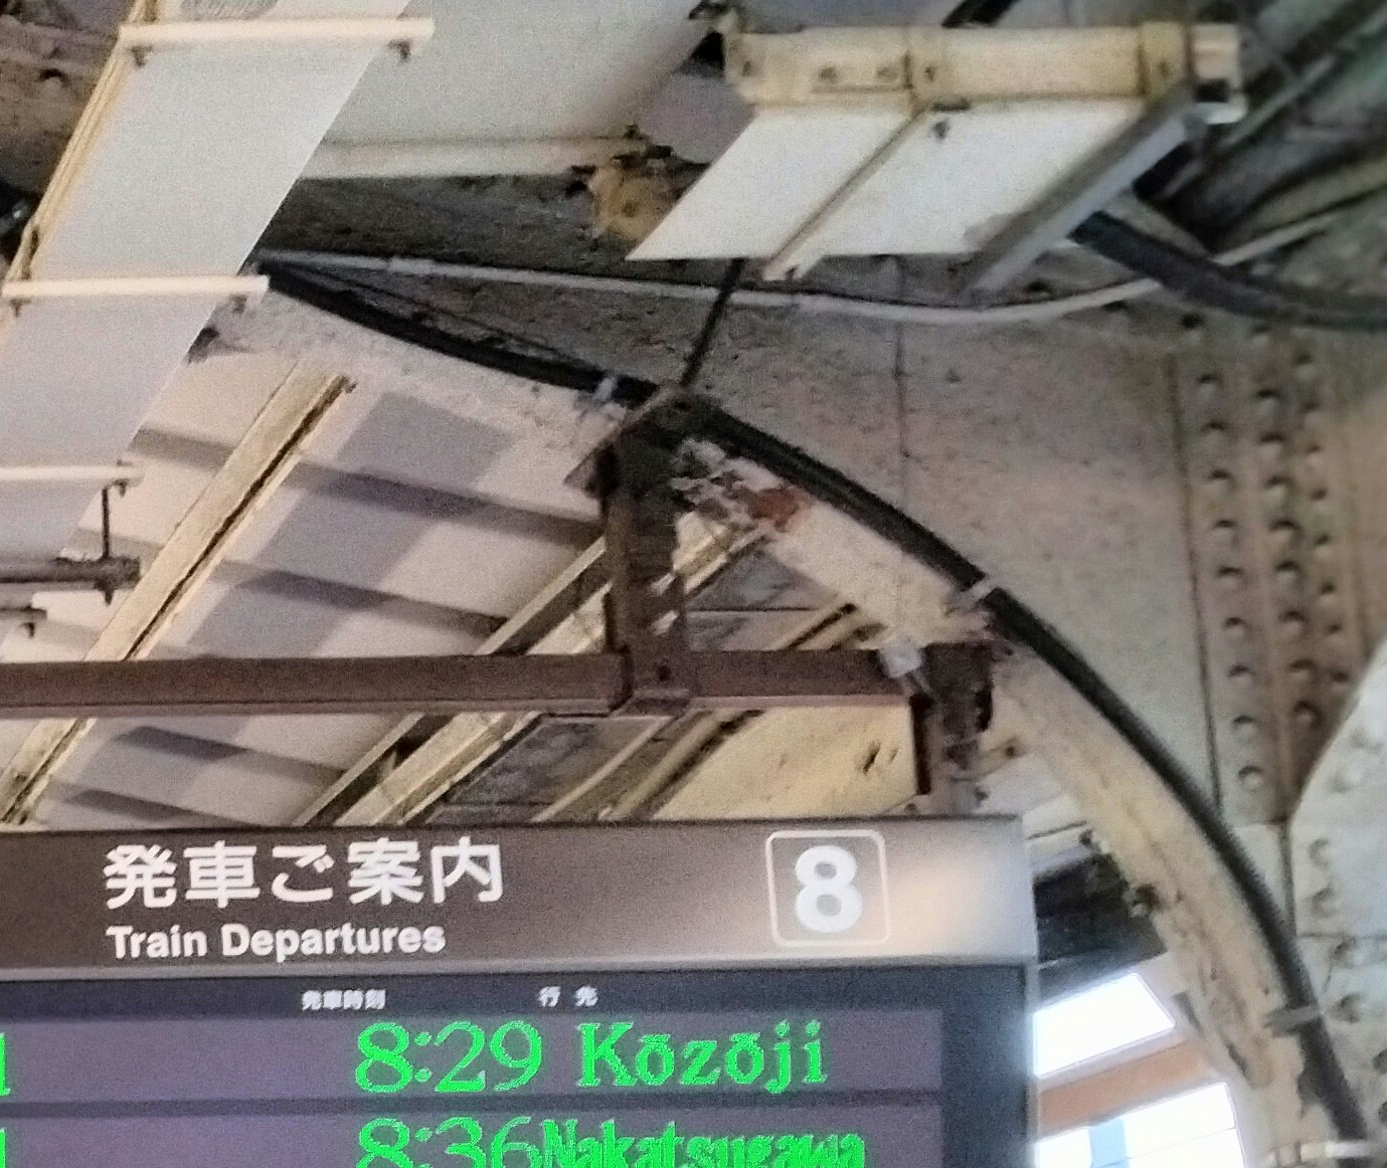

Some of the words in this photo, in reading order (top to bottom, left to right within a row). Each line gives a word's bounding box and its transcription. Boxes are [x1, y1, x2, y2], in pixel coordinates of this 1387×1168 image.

[104, 837, 504, 905] 発車ご案内
[793, 845, 862, 933] 8
[106, 925, 209, 960] Train
[221, 923, 447, 965] Departures
[355, 1022, 543, 1094] 8:29
